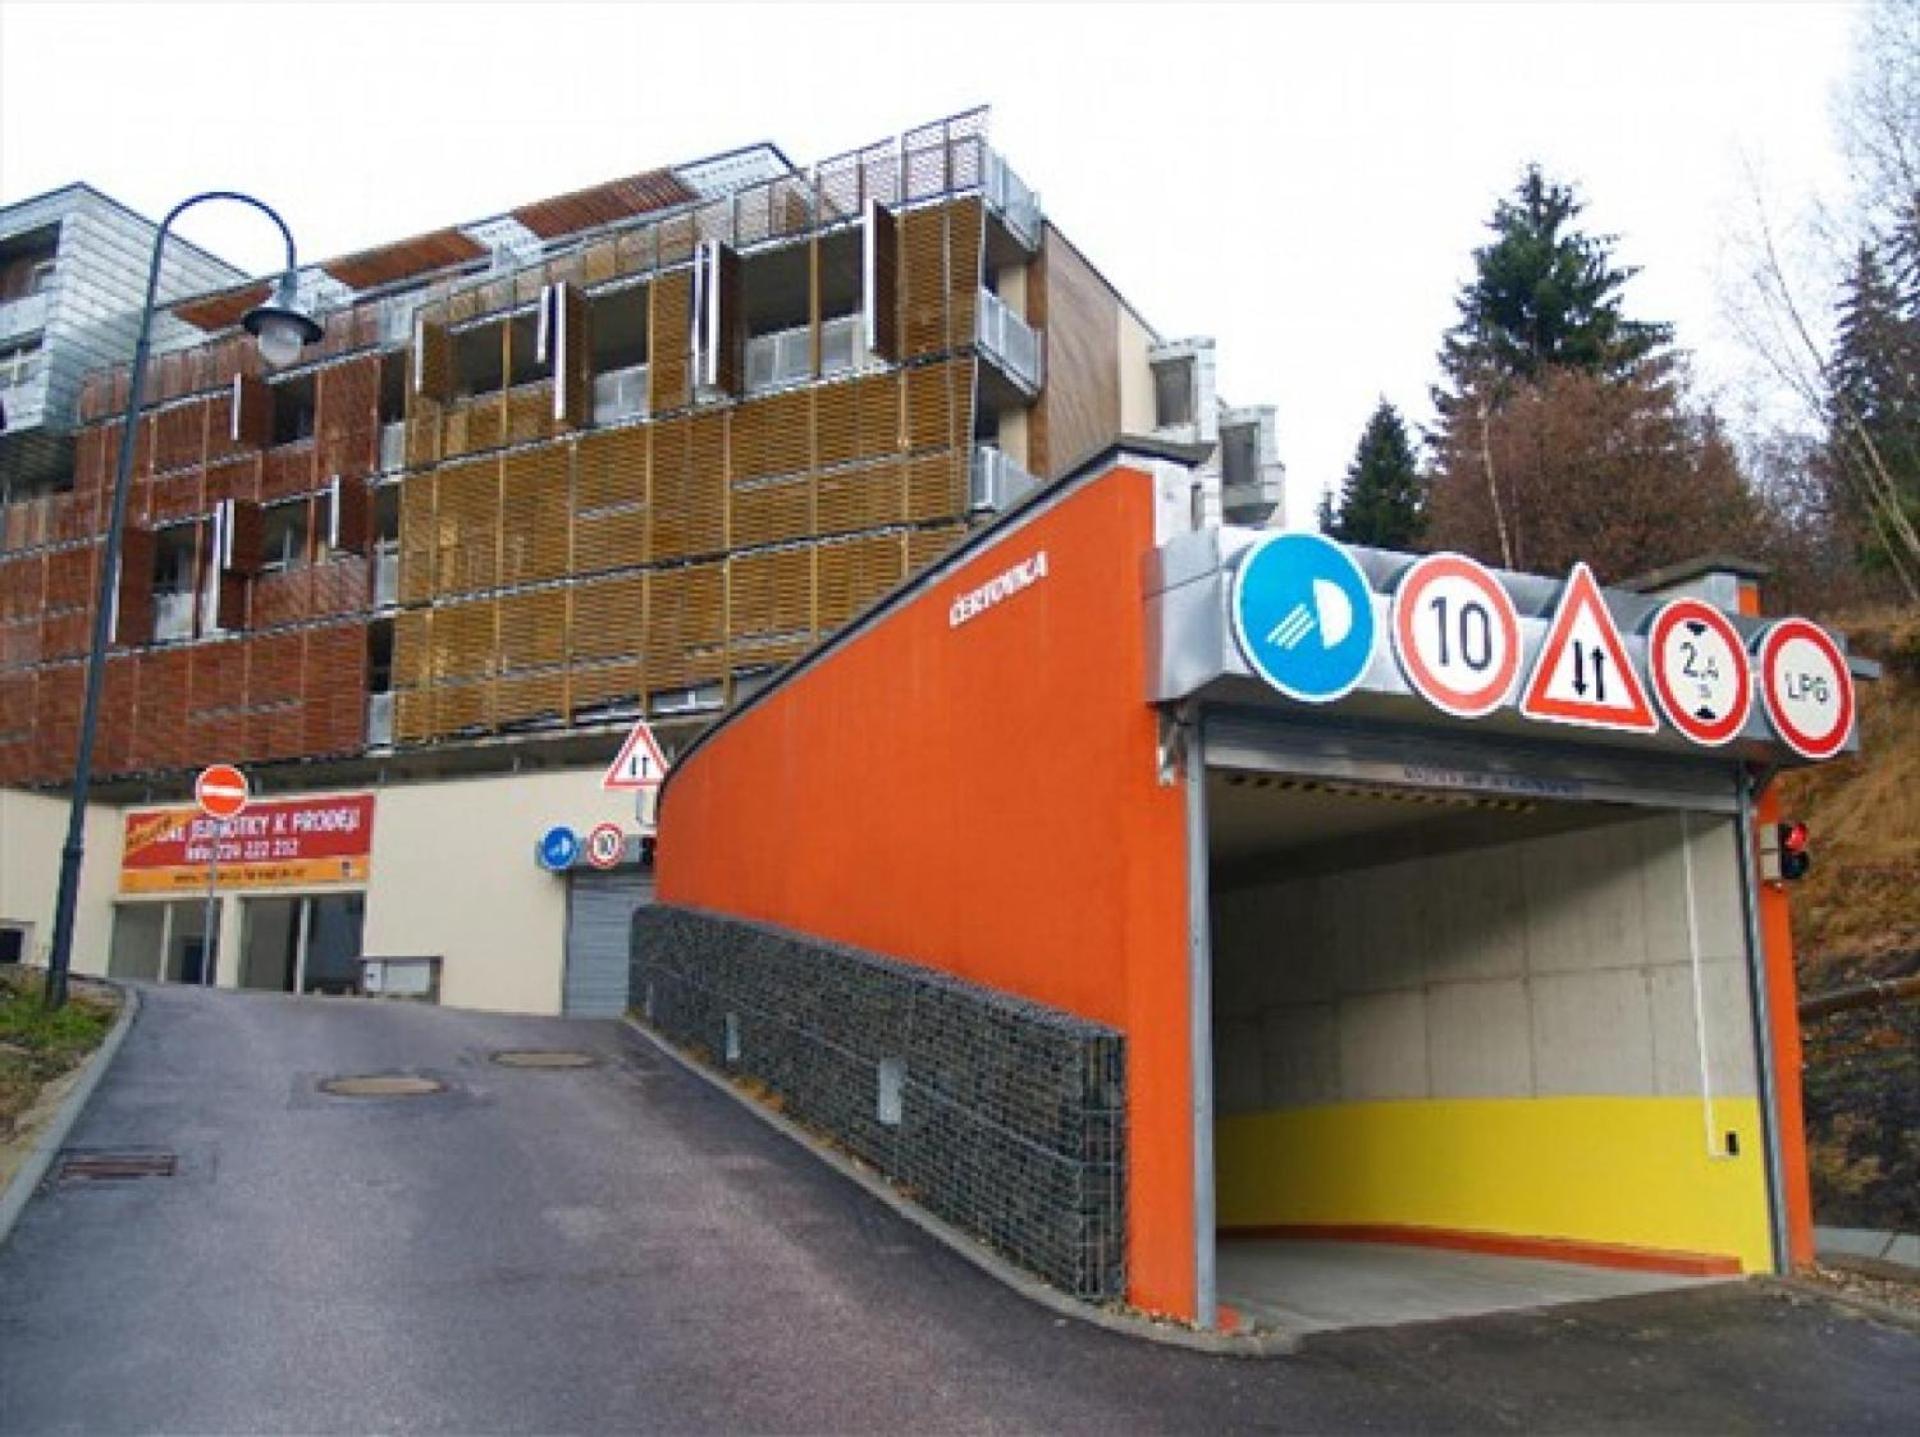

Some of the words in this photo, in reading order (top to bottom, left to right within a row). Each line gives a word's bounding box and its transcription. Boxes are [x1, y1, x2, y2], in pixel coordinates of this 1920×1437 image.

[1430, 596, 1492, 671] 10
[1785, 673, 1830, 703] LPG
[597, 833, 615, 855] 10
